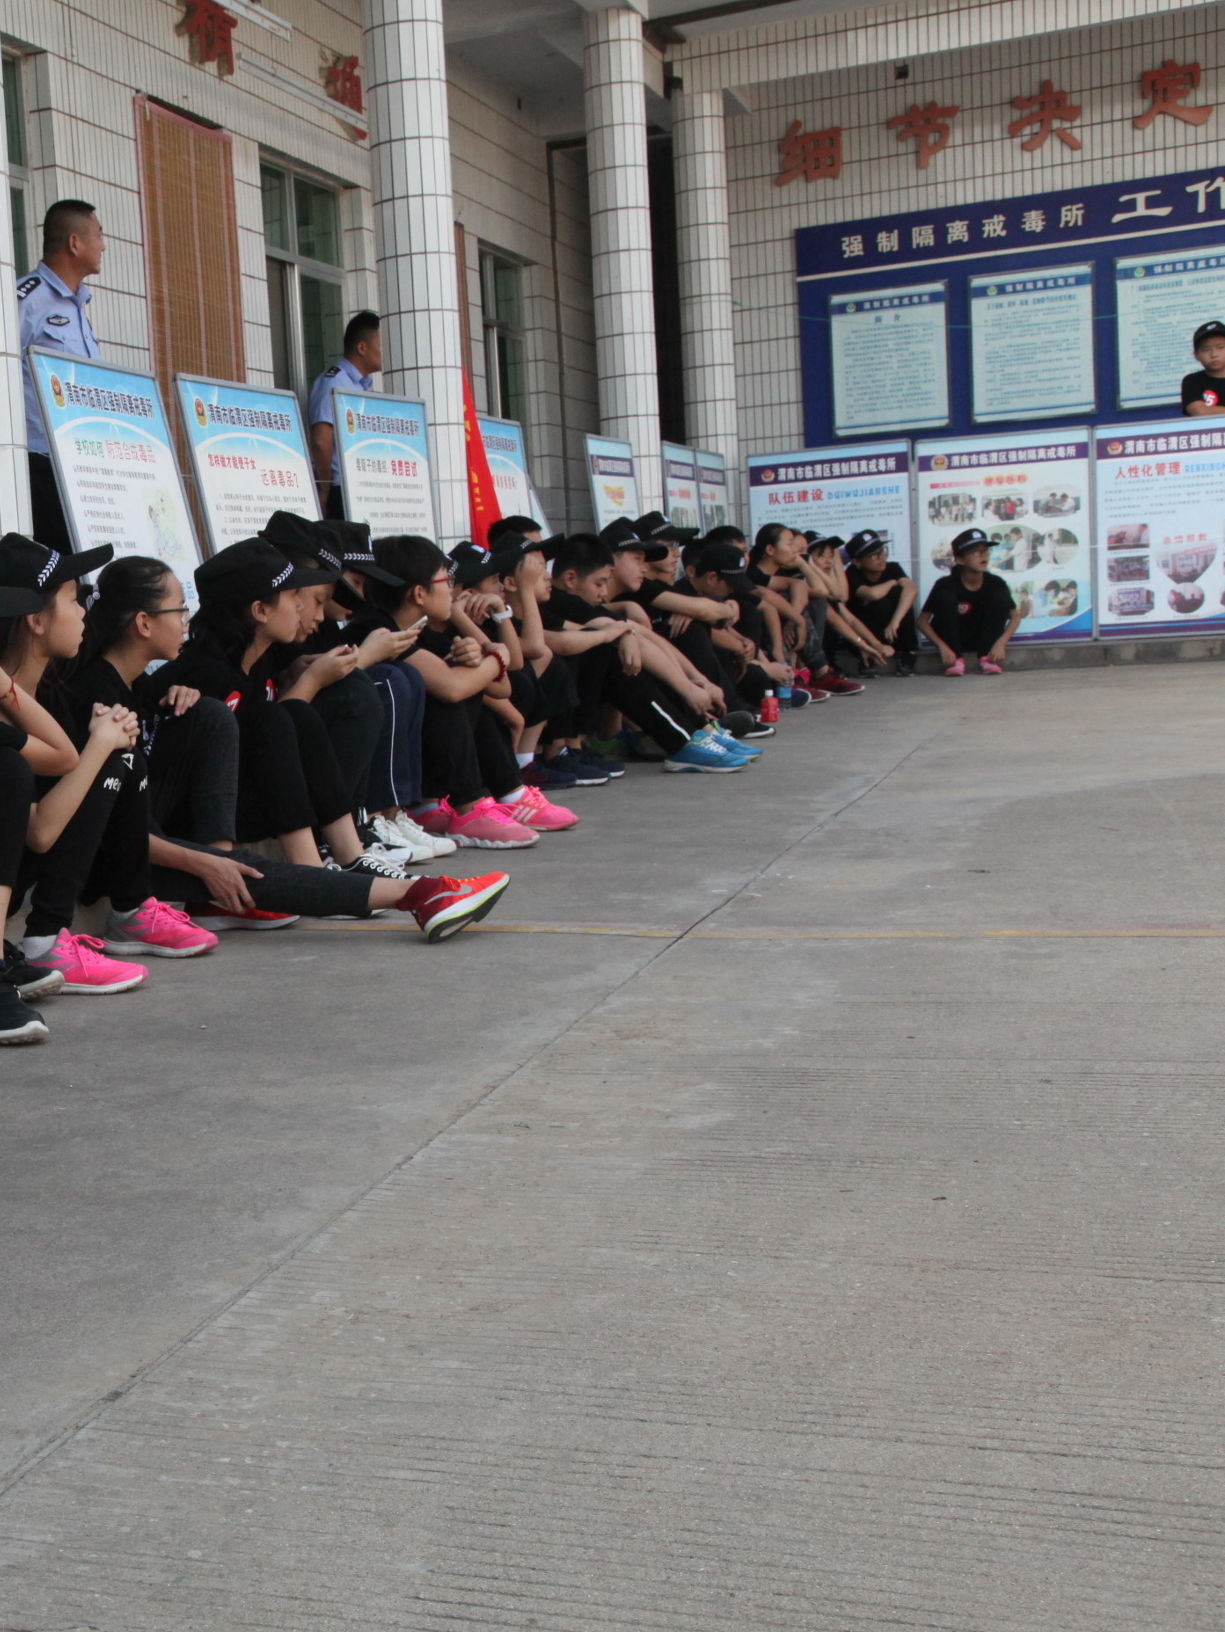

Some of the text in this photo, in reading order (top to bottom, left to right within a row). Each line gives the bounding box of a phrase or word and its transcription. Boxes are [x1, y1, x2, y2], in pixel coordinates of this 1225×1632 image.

[775, 59, 1214, 187] 细节决定
[842, 203, 1084, 258] 强制隔离戒毒所
[1124, 432, 1225, 454] 渭南市临渭区强制隔
